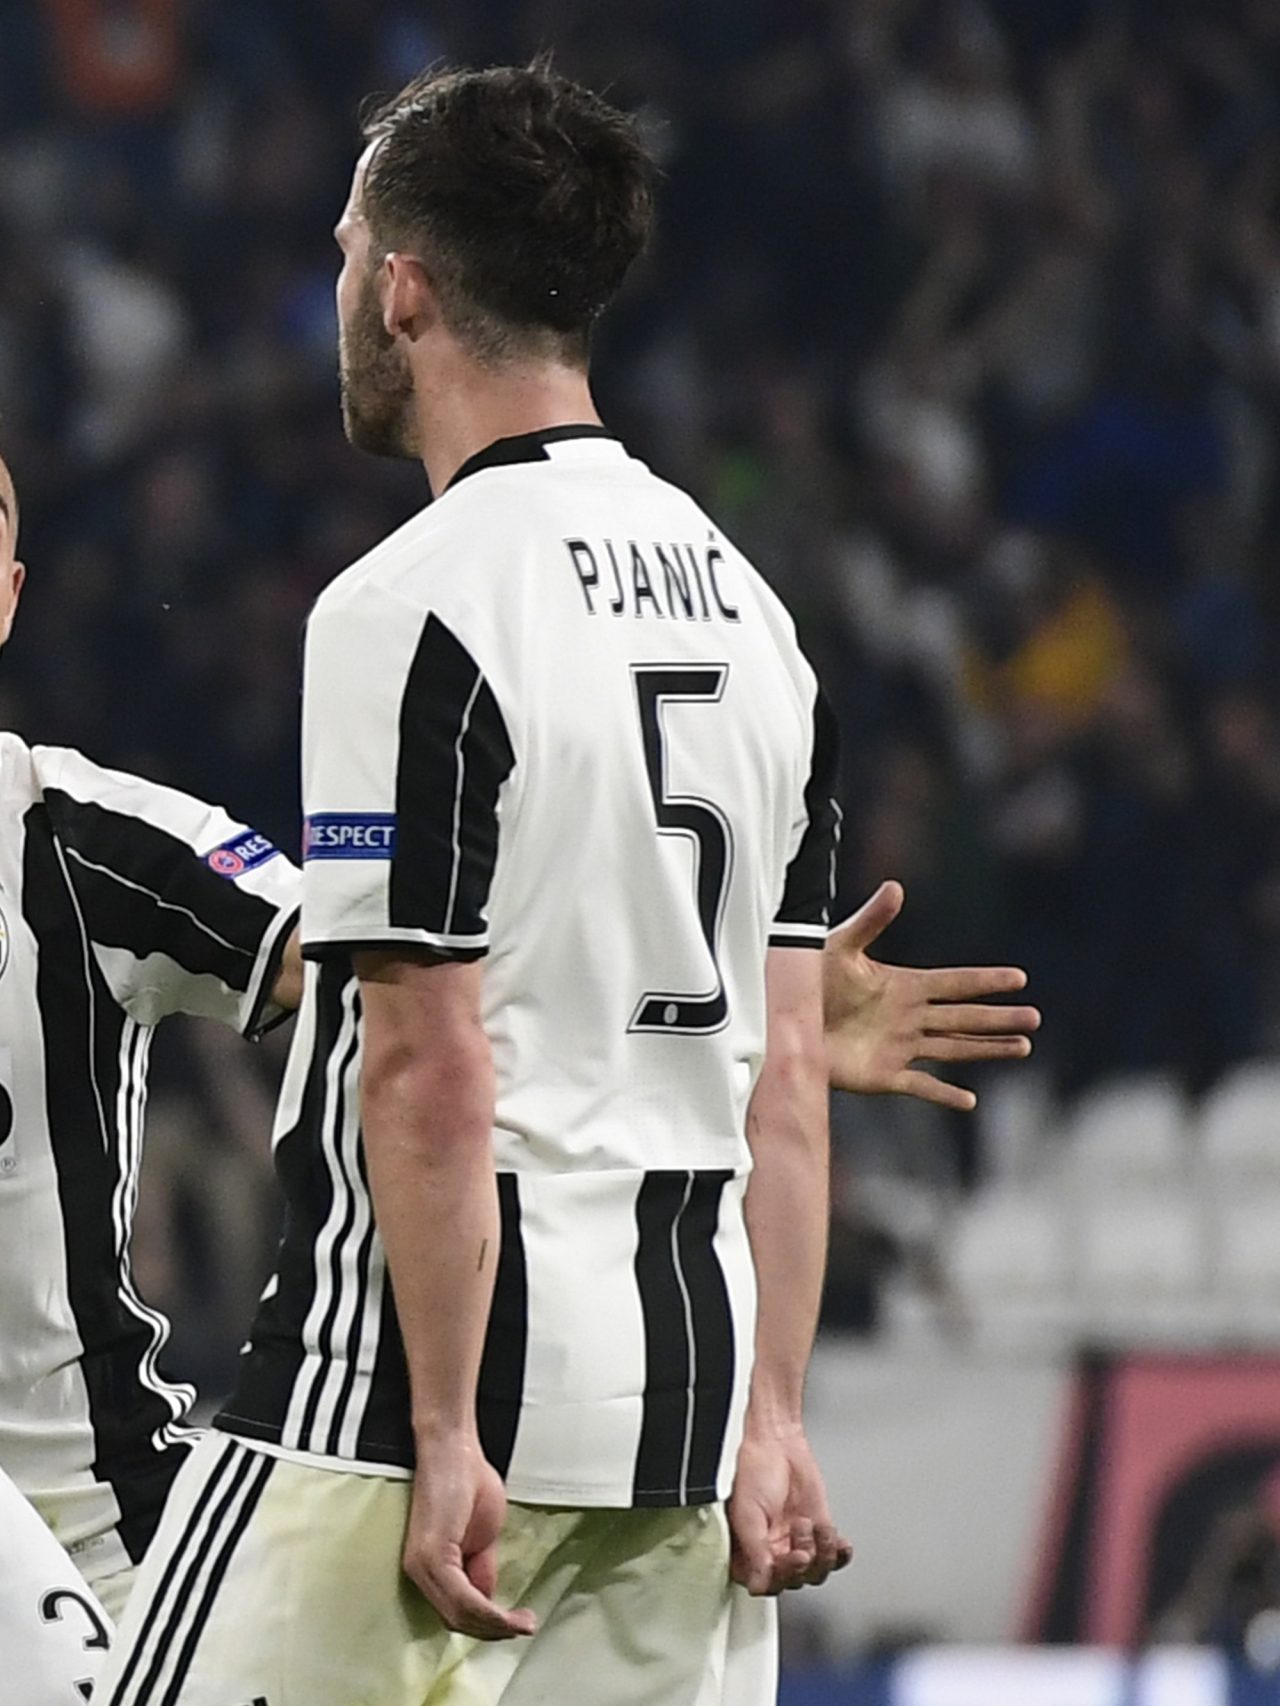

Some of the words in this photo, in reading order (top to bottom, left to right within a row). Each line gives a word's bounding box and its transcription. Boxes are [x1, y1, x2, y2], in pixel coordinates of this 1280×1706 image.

[562, 529, 742, 624] PJANIĆ
[311, 825, 395, 847] ESPECT
[624, 662, 734, 1035] 5
